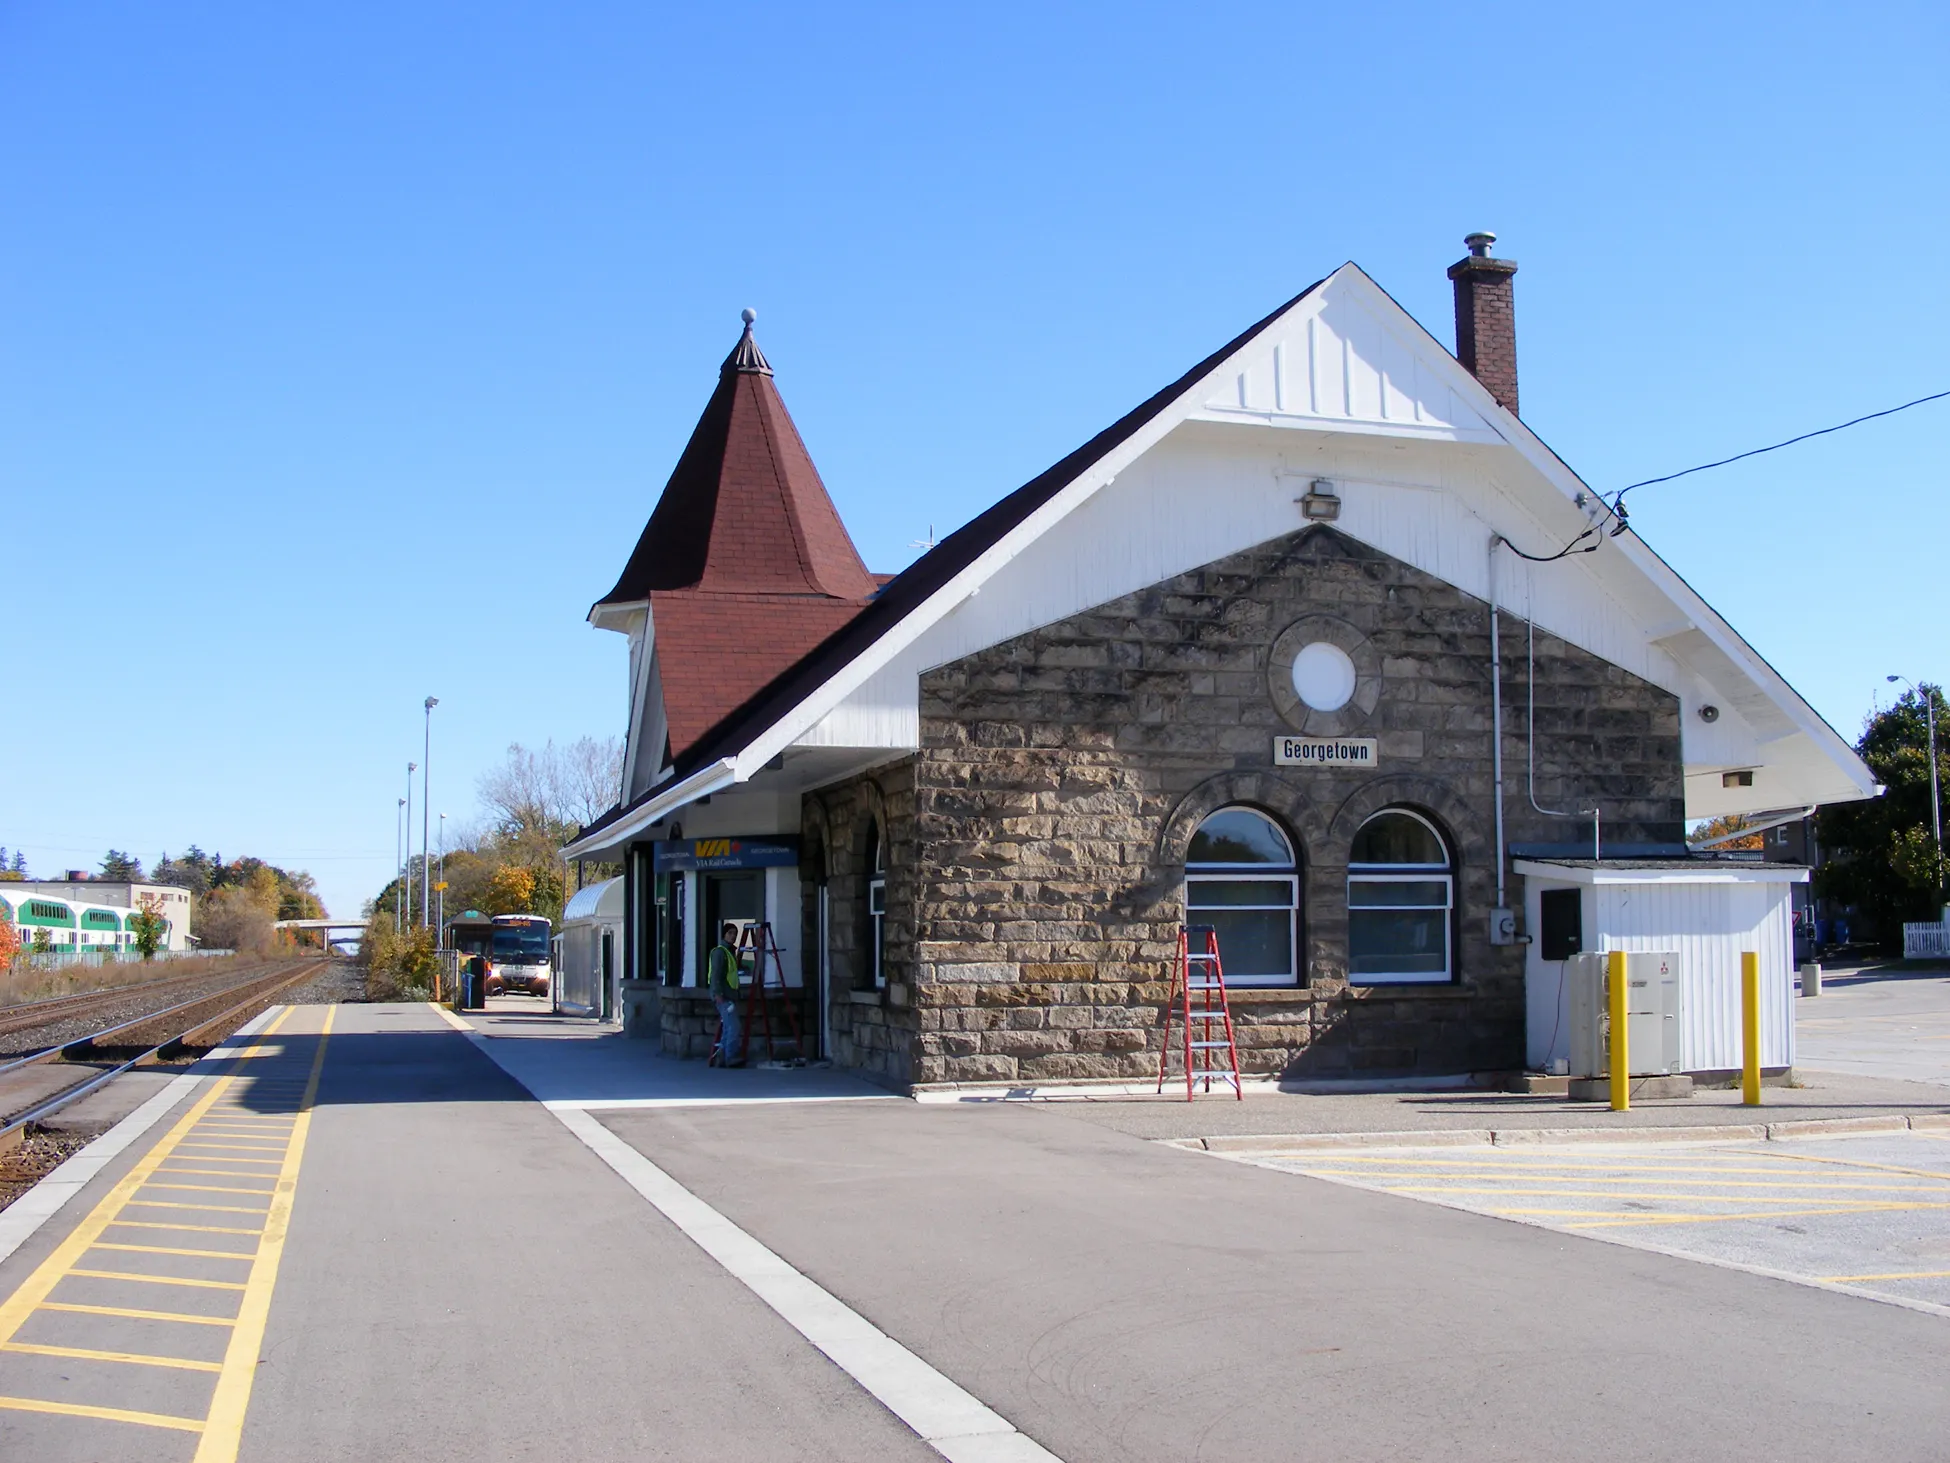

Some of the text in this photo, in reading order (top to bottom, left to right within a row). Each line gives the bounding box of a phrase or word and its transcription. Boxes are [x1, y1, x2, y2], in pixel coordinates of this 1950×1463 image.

[1284, 739, 1368, 762] Georgetown
[695, 839, 731, 857] VIA
[696, 858, 742, 867] VIA Rail Canada
